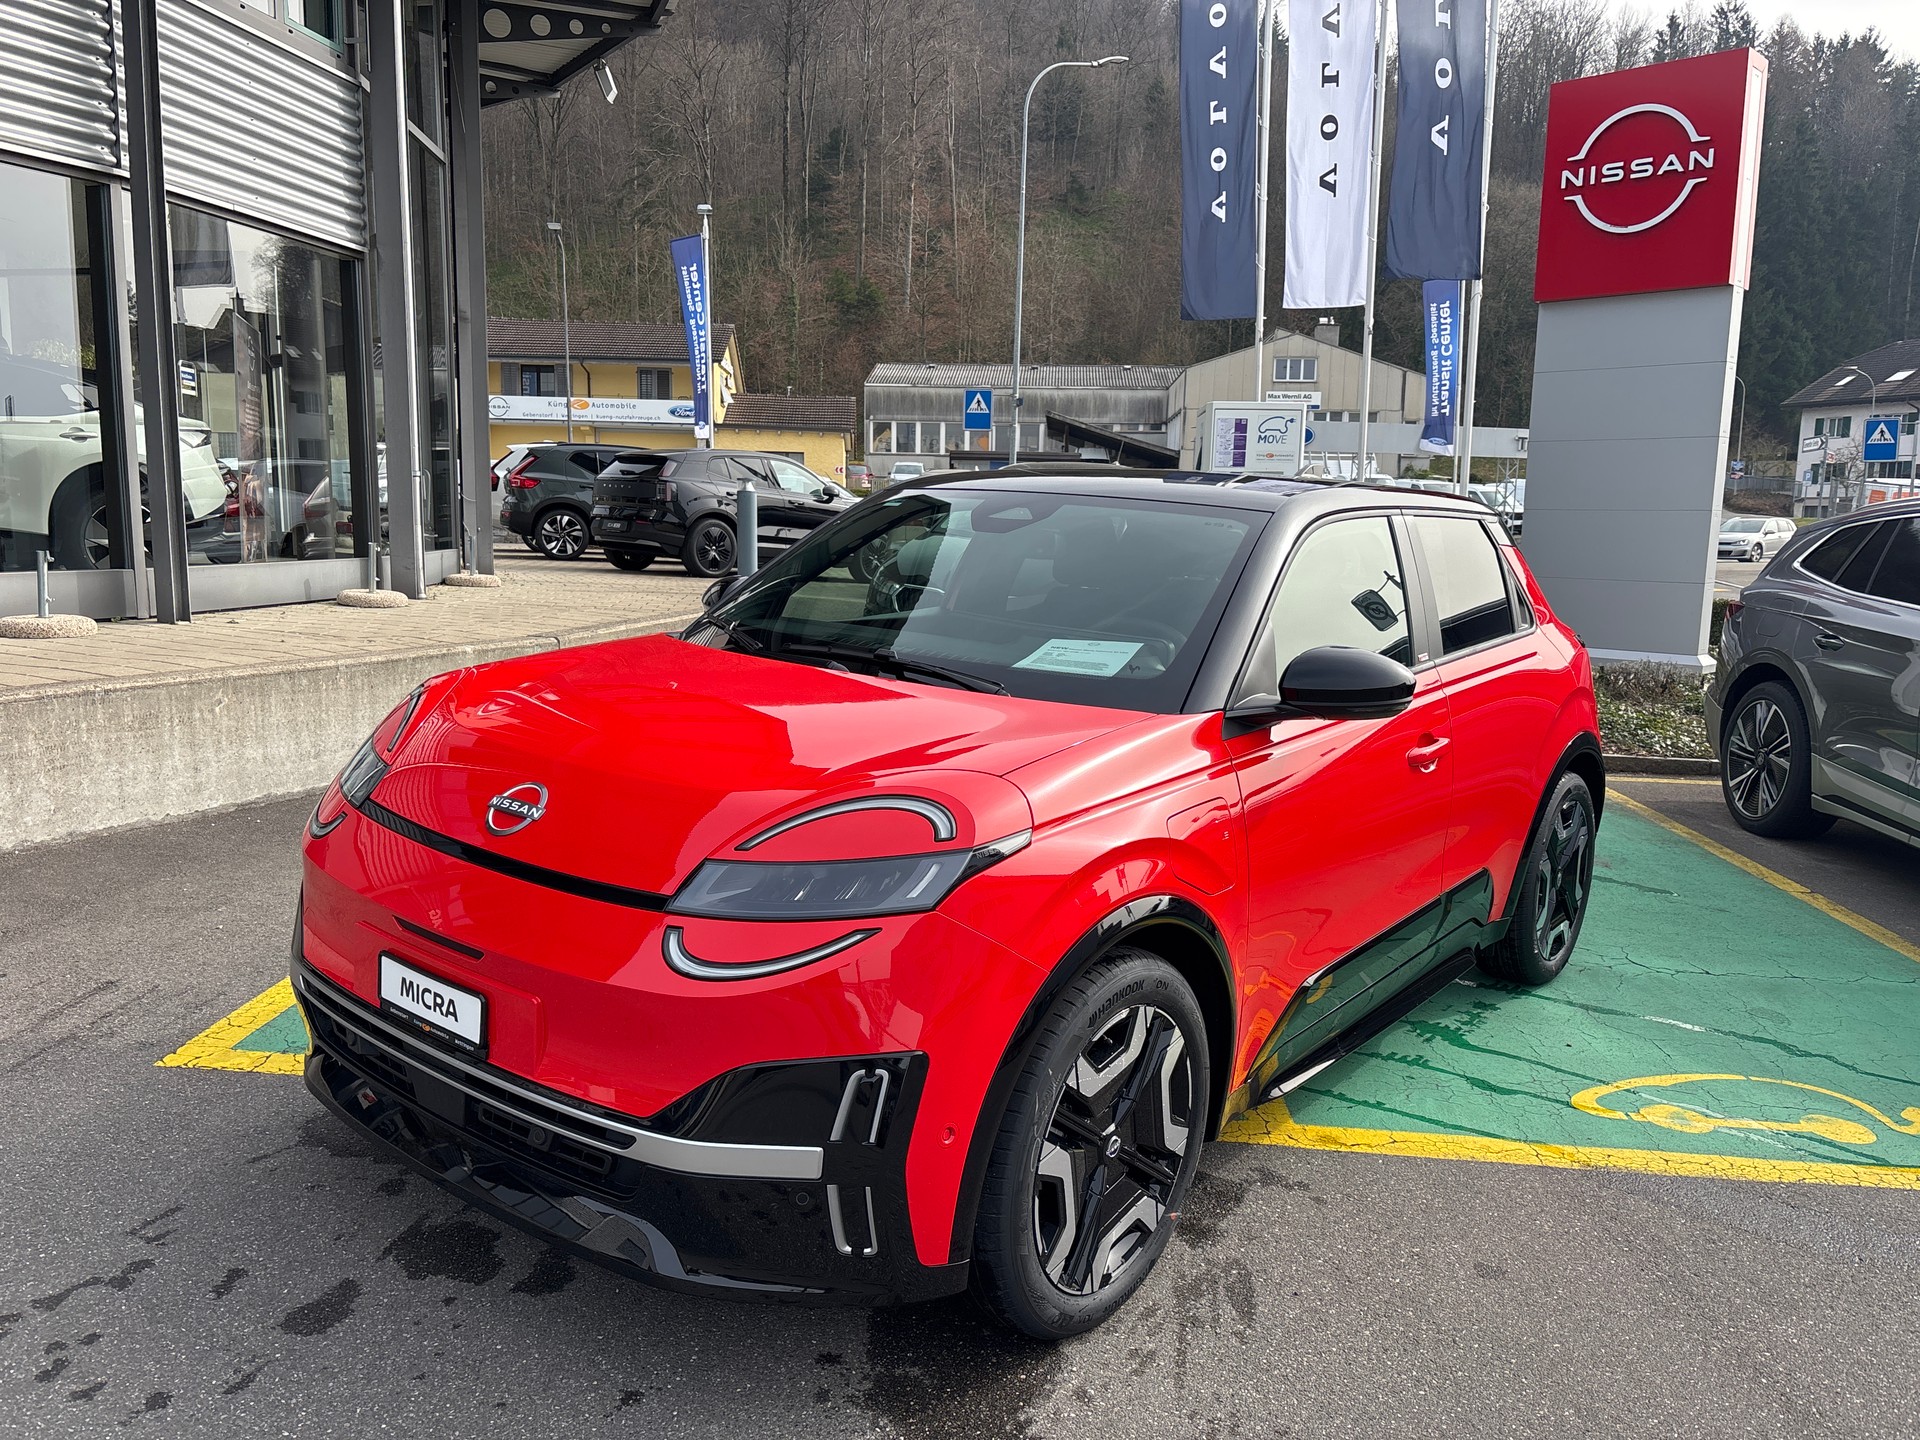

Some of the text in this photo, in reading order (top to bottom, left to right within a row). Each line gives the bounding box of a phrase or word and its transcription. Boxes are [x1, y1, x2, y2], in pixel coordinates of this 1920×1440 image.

[1560, 147, 1715, 190] NISSAN
[547, 401, 637, 410] Küng Automobile
[1257, 434, 1288, 445] MOVE
[489, 796, 543, 818] NISSAN
[976, 848, 1002, 860] NISSA
[400, 976, 459, 1023] MICRA
